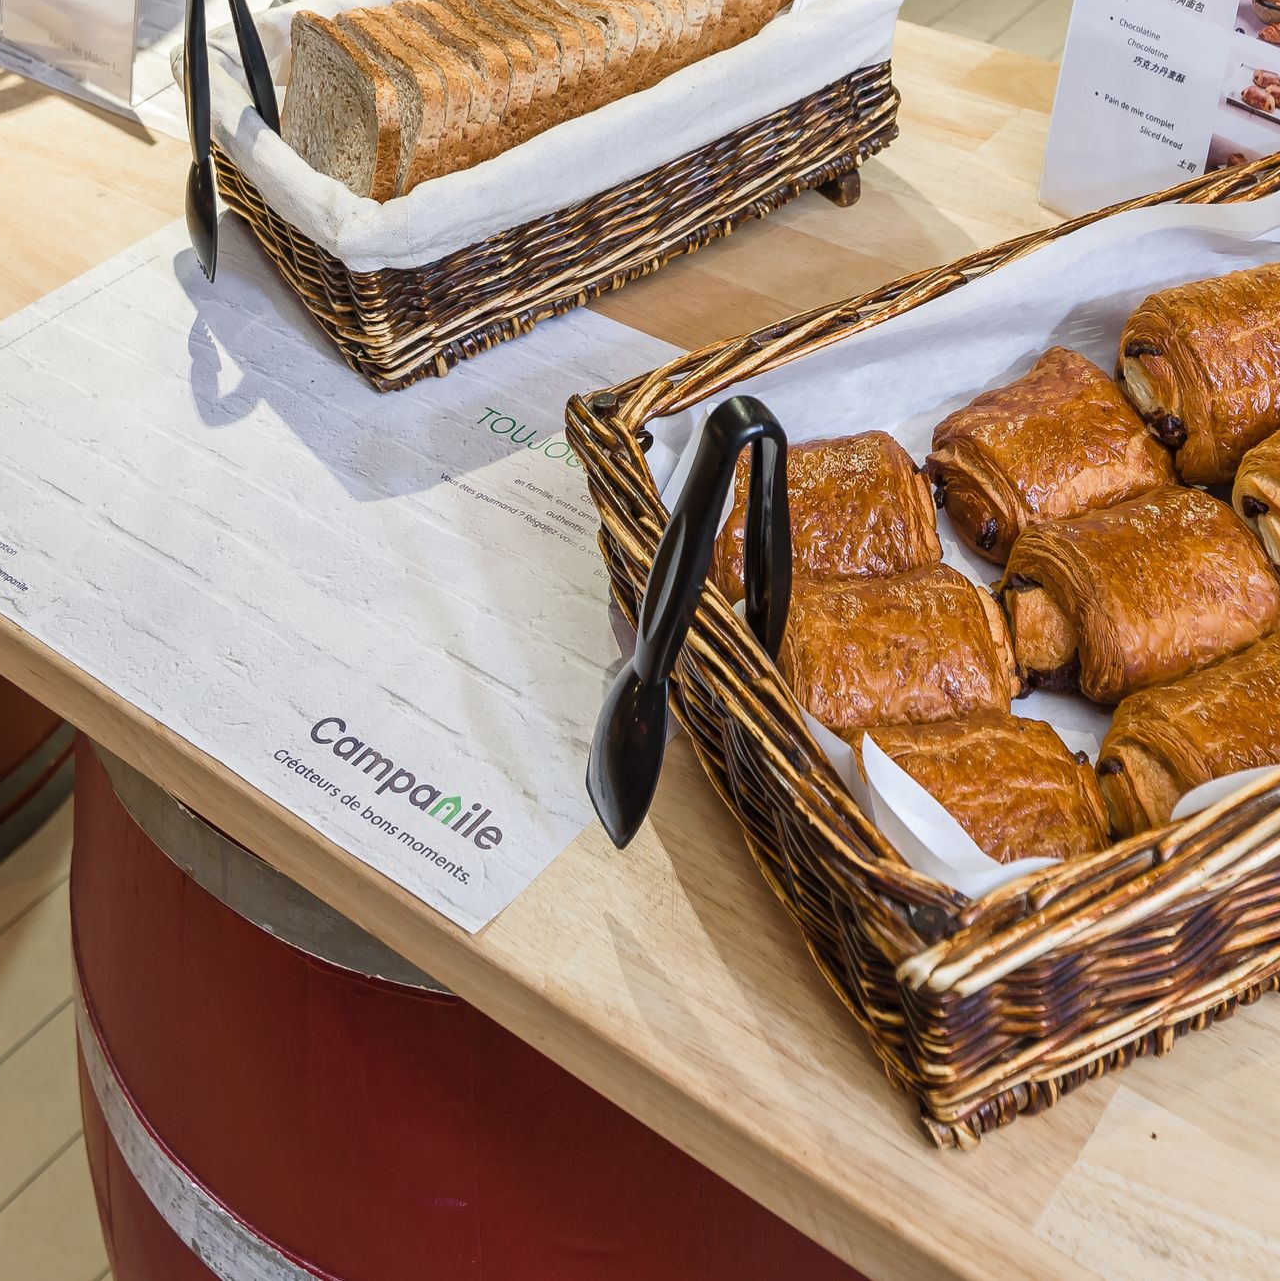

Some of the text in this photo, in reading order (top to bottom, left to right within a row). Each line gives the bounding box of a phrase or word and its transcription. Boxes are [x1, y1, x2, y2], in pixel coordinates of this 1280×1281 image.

[1119, 18, 1161, 41] Chocolatine
[1127, 38, 1169, 60] Chocolatine
[1104, 94, 1174, 130] Pain de mie complet
[1139, 125, 1183, 150] Sliced bread
[1177, 159, 1197, 173] 土司
[477, 407, 582, 467] TOUJOU
[441, 472, 459, 487] Vous
[459, 483, 476, 496] êtes
[475, 491, 519, 515] gourmand
[514, 478, 525, 487] en
[525, 482, 553, 502] famille,
[555, 496, 578, 514] entre
[310, 717, 503, 850] Campanile
[273, 749, 471, 885] Créateurs de bons moments.
